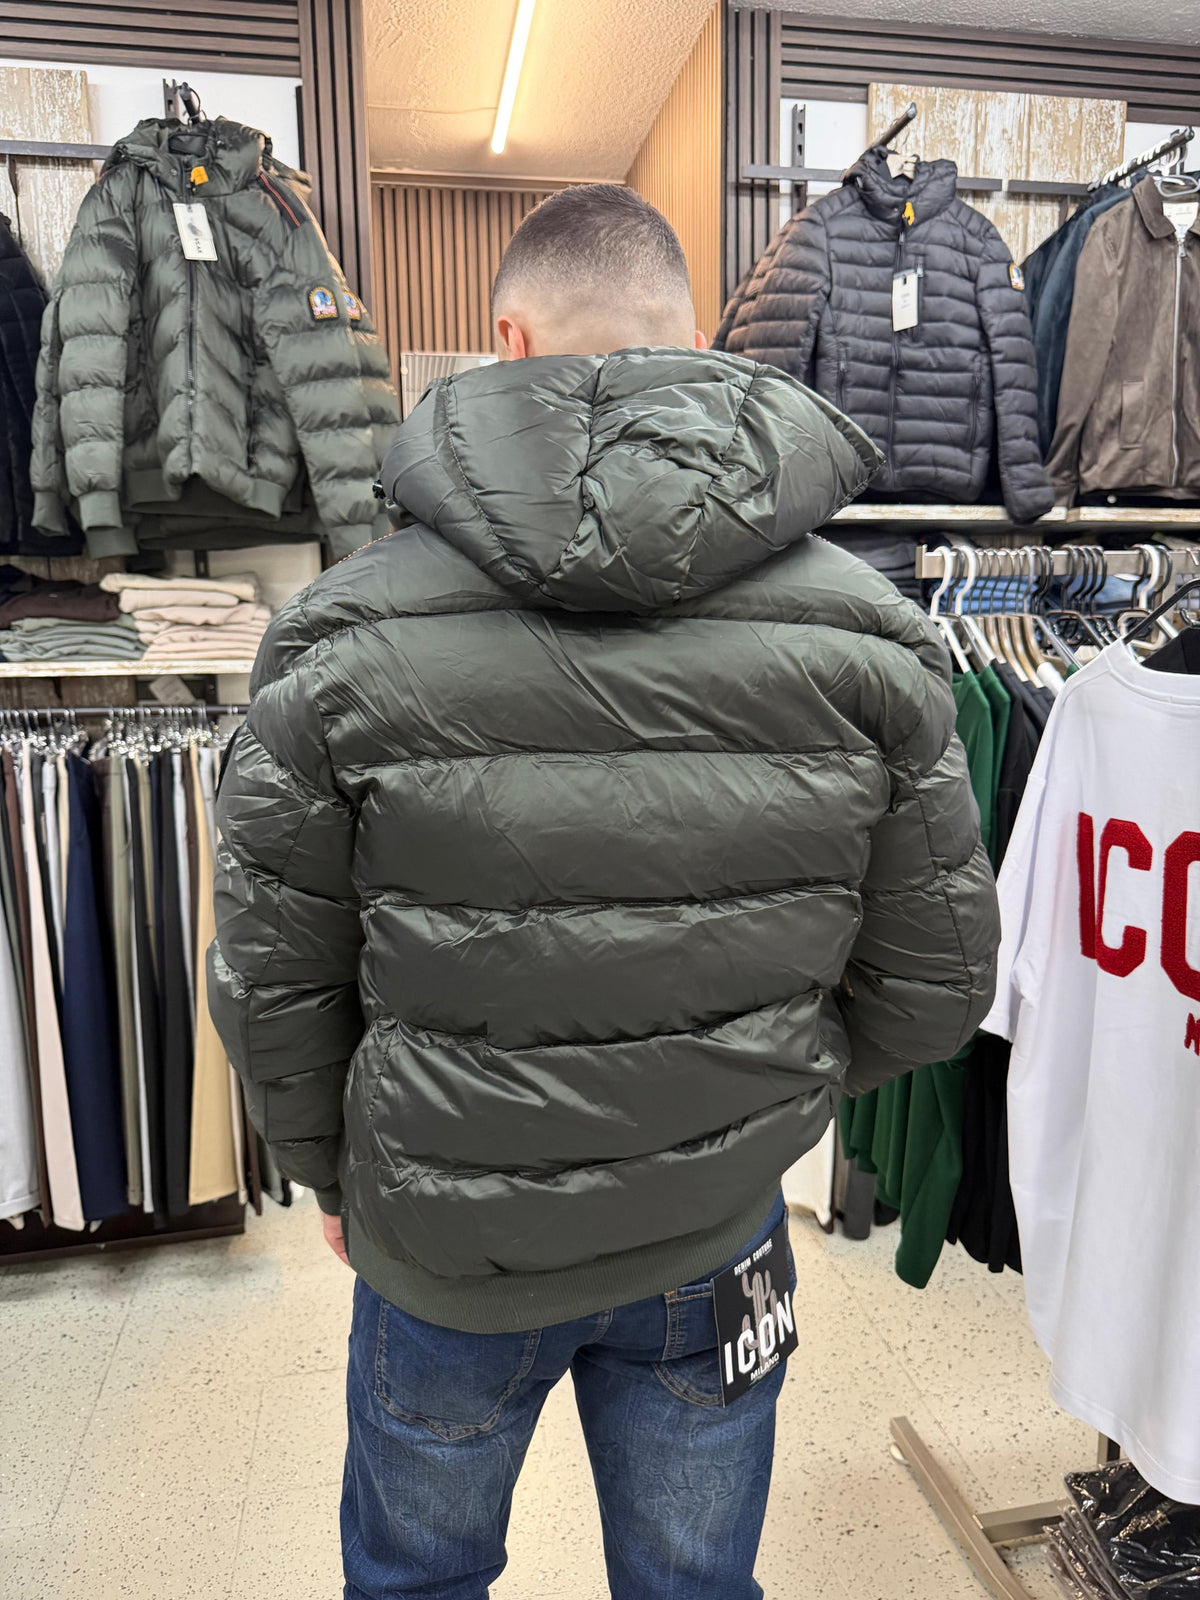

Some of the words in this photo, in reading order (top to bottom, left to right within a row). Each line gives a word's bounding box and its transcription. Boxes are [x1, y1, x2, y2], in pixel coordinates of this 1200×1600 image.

[734, 1256, 751, 1276] DENIM
[753, 1238, 772, 1262] COUTURE
[724, 1291, 794, 1385] ICON
[750, 1352, 780, 1381] MILANO
